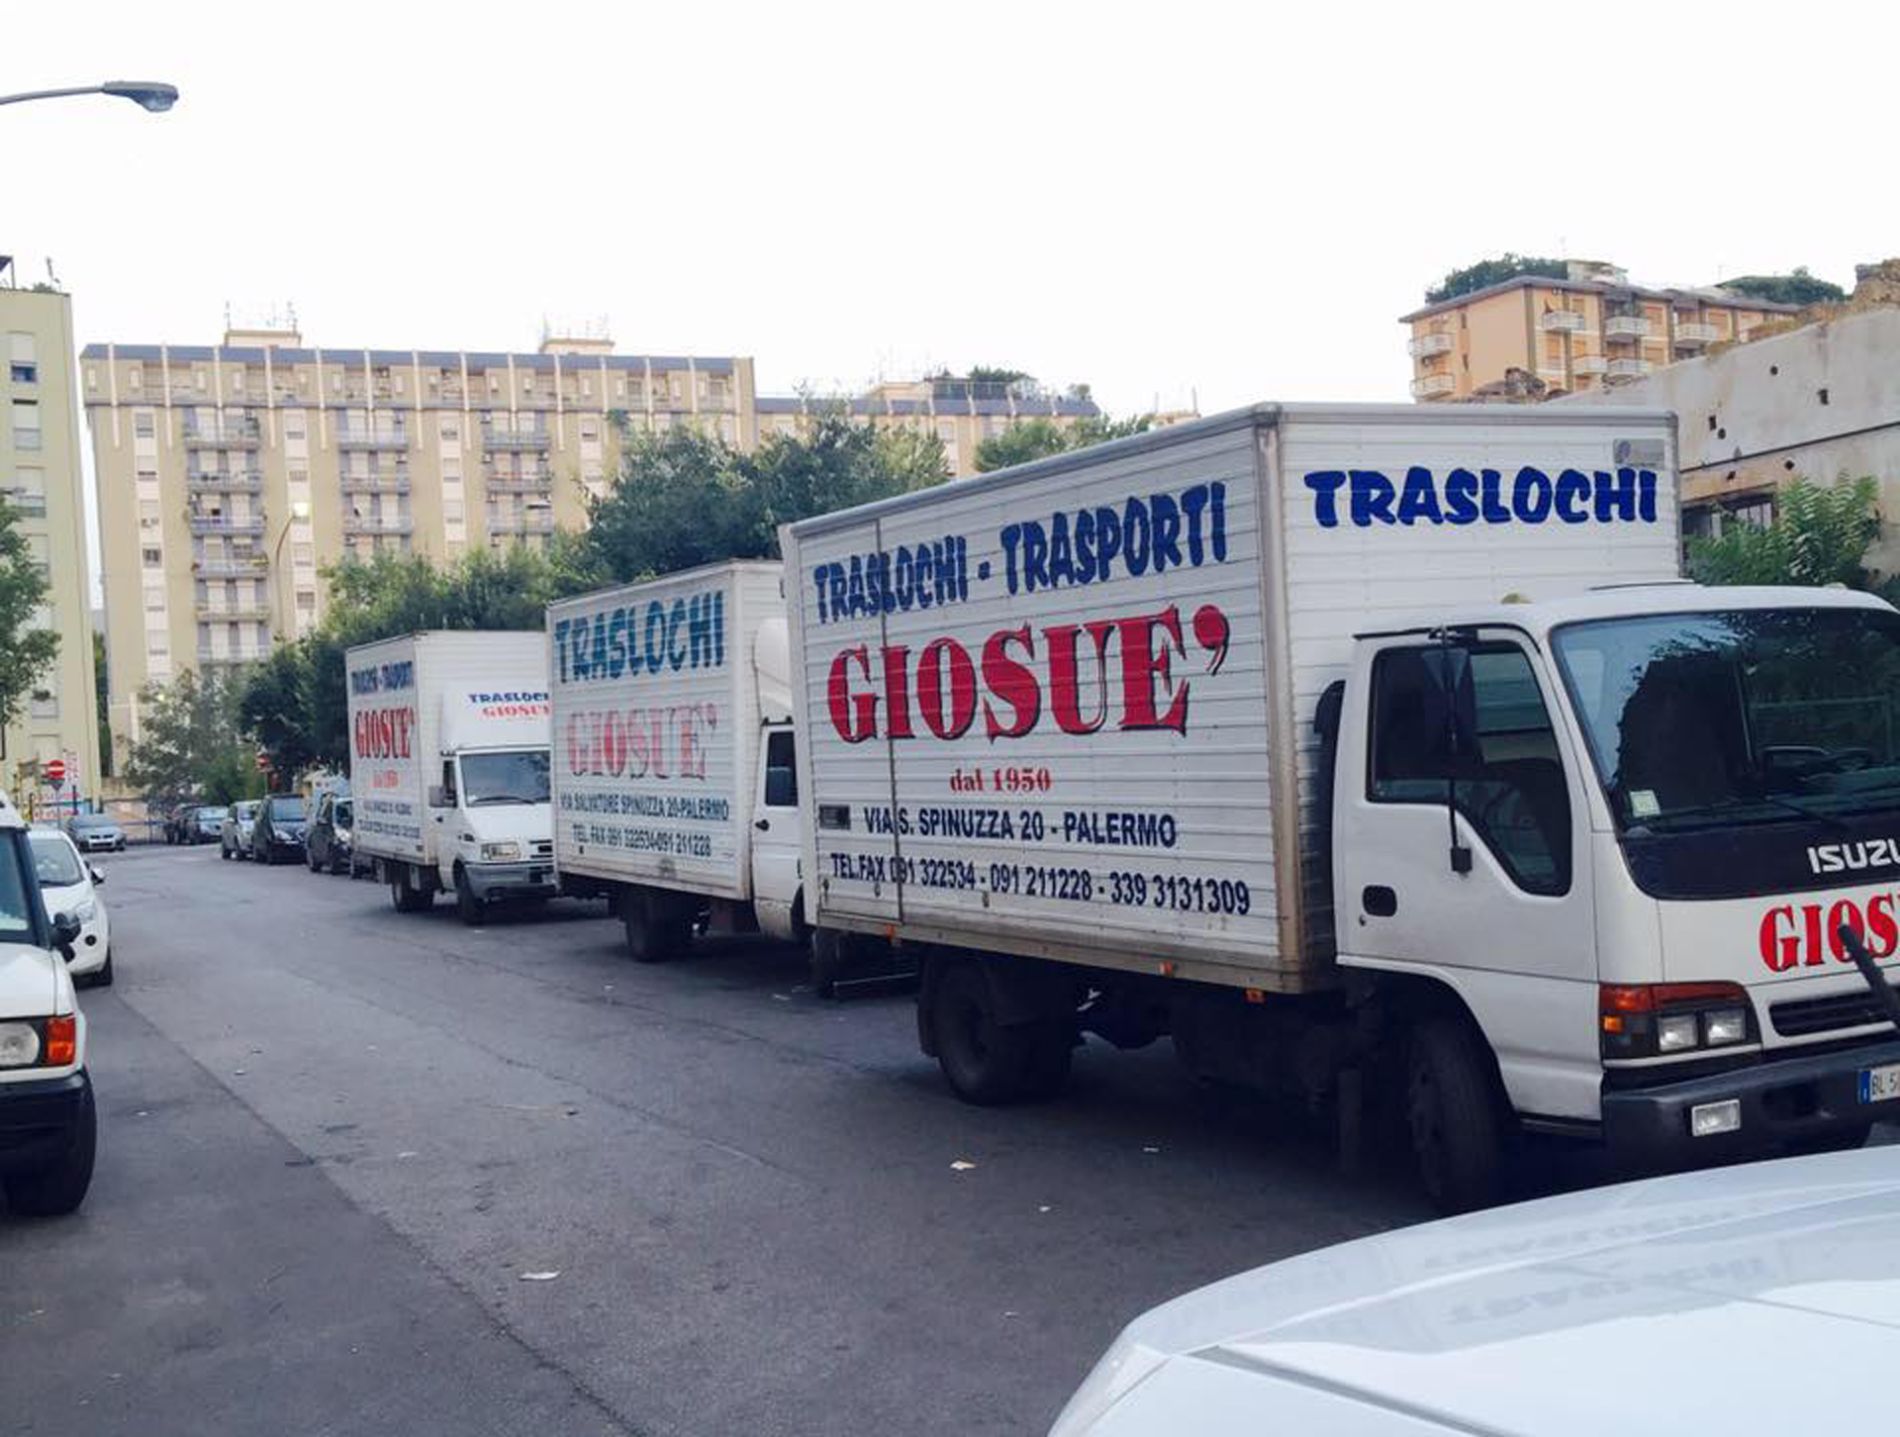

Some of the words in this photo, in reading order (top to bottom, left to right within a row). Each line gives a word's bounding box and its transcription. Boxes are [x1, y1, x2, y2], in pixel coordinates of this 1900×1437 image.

[1304, 466, 1657, 527] TRASLOCHI
[814, 535, 969, 623] TRASLOCHI
[1000, 481, 1226, 595] TRASPORTI
[555, 590, 724, 683] TRASLOCHI
[950, 768, 984, 792] dal
[992, 767, 1052, 792] 1950
[864, 806, 894, 834] VIA
[899, 808, 915, 835] S.
[919, 807, 1015, 839] SPINUZZA
[1020, 811, 1044, 841] 20
[1063, 812, 1177, 848] PALERMO
[890, 856, 916, 884] 091
[919, 858, 976, 890] 322534
[990, 864, 1019, 893] 091
[1025, 866, 1093, 900] 211228
[1109, 870, 1147, 905] 339
[1153, 875, 1251, 916] 3131309
[1760, 892, 1900, 973] GIOS
